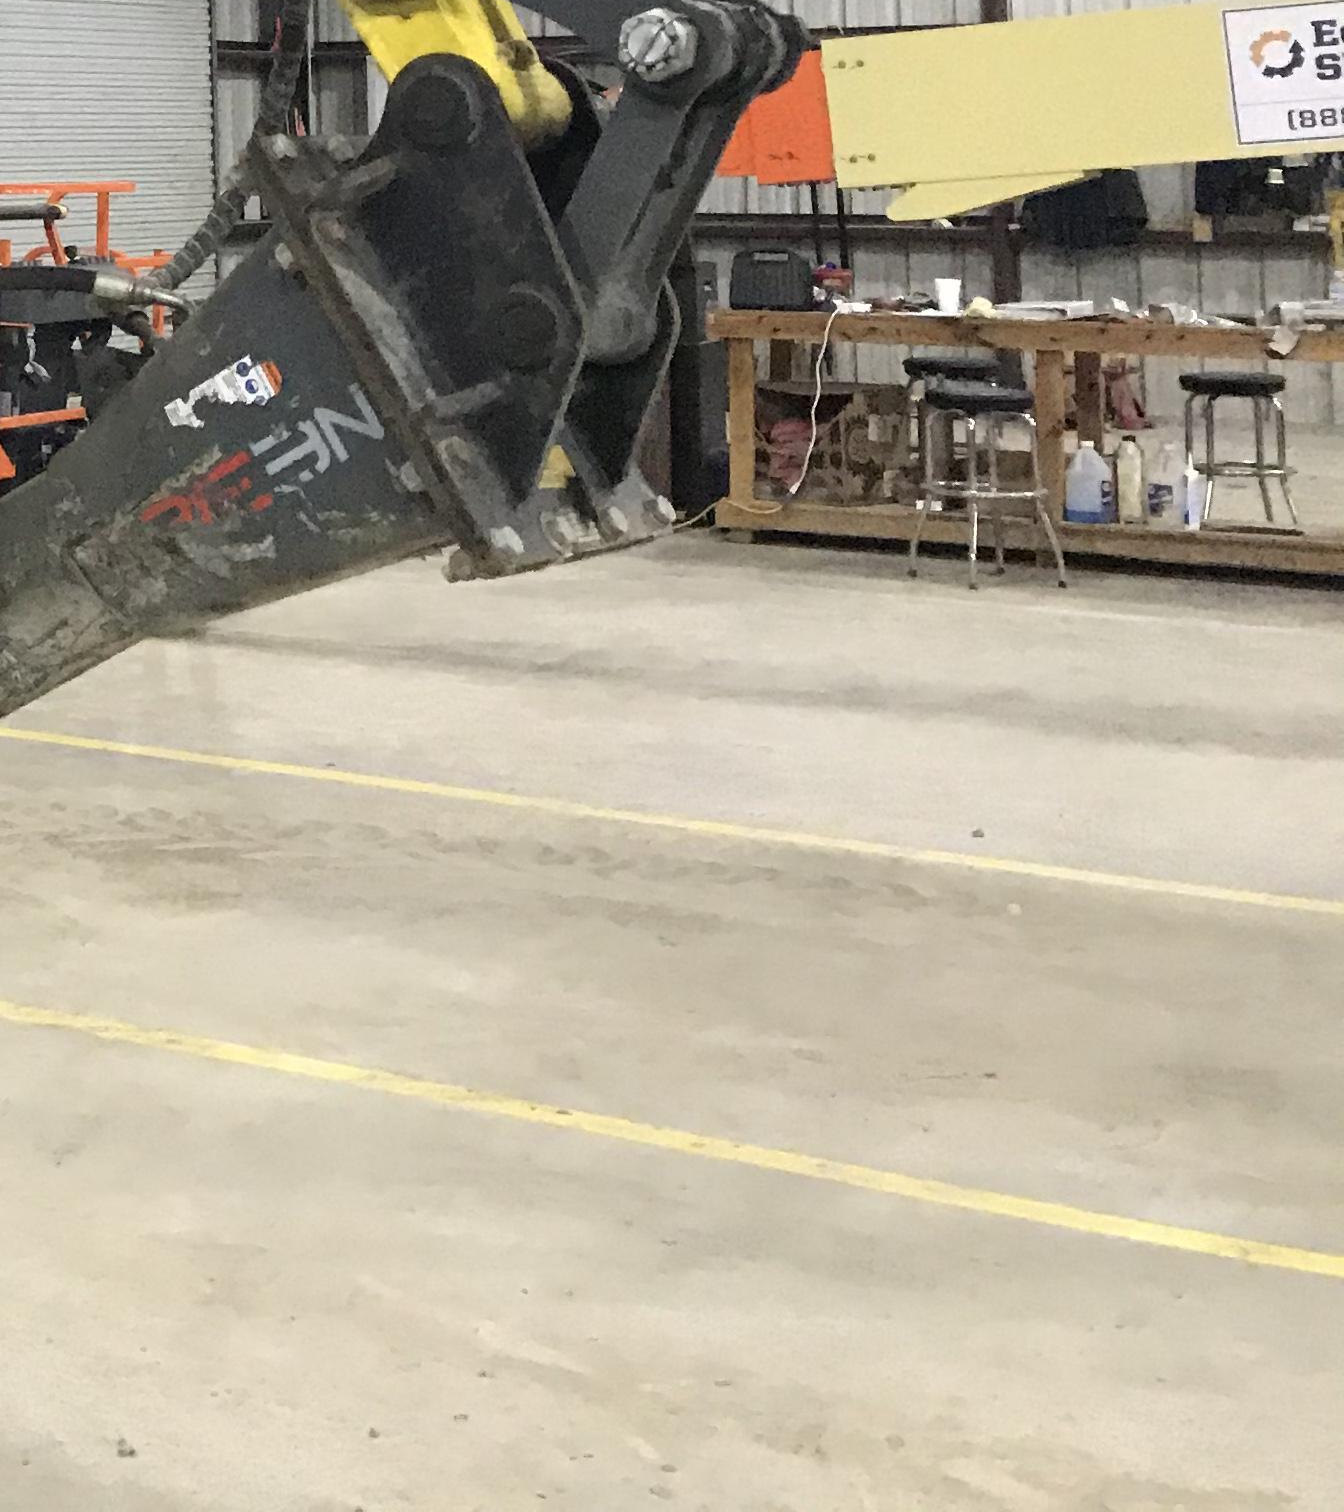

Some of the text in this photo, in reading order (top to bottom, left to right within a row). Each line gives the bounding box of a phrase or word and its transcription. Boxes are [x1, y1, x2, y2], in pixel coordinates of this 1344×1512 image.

[1310, 18, 1344, 48] E
[1315, 52, 1344, 80] S
[1287, 107, 1344, 131] (88
